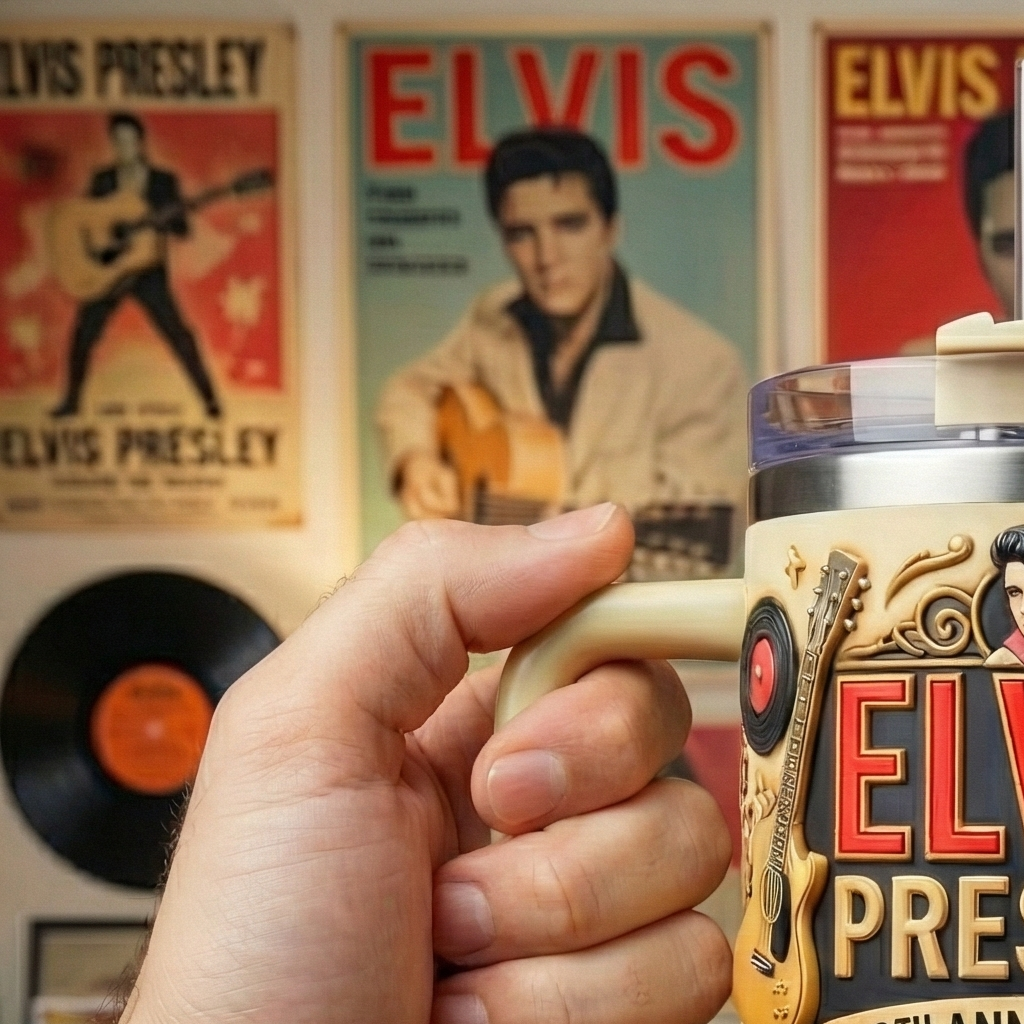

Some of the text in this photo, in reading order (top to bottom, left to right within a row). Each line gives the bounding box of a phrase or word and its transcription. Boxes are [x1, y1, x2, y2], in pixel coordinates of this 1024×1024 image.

[0, 38, 266, 98] LVIS PRESLEY
[835, 44, 998, 118] ELVIS
[364, 46, 741, 171] ELVIS
[116, 425, 278, 467] PRESLEY
